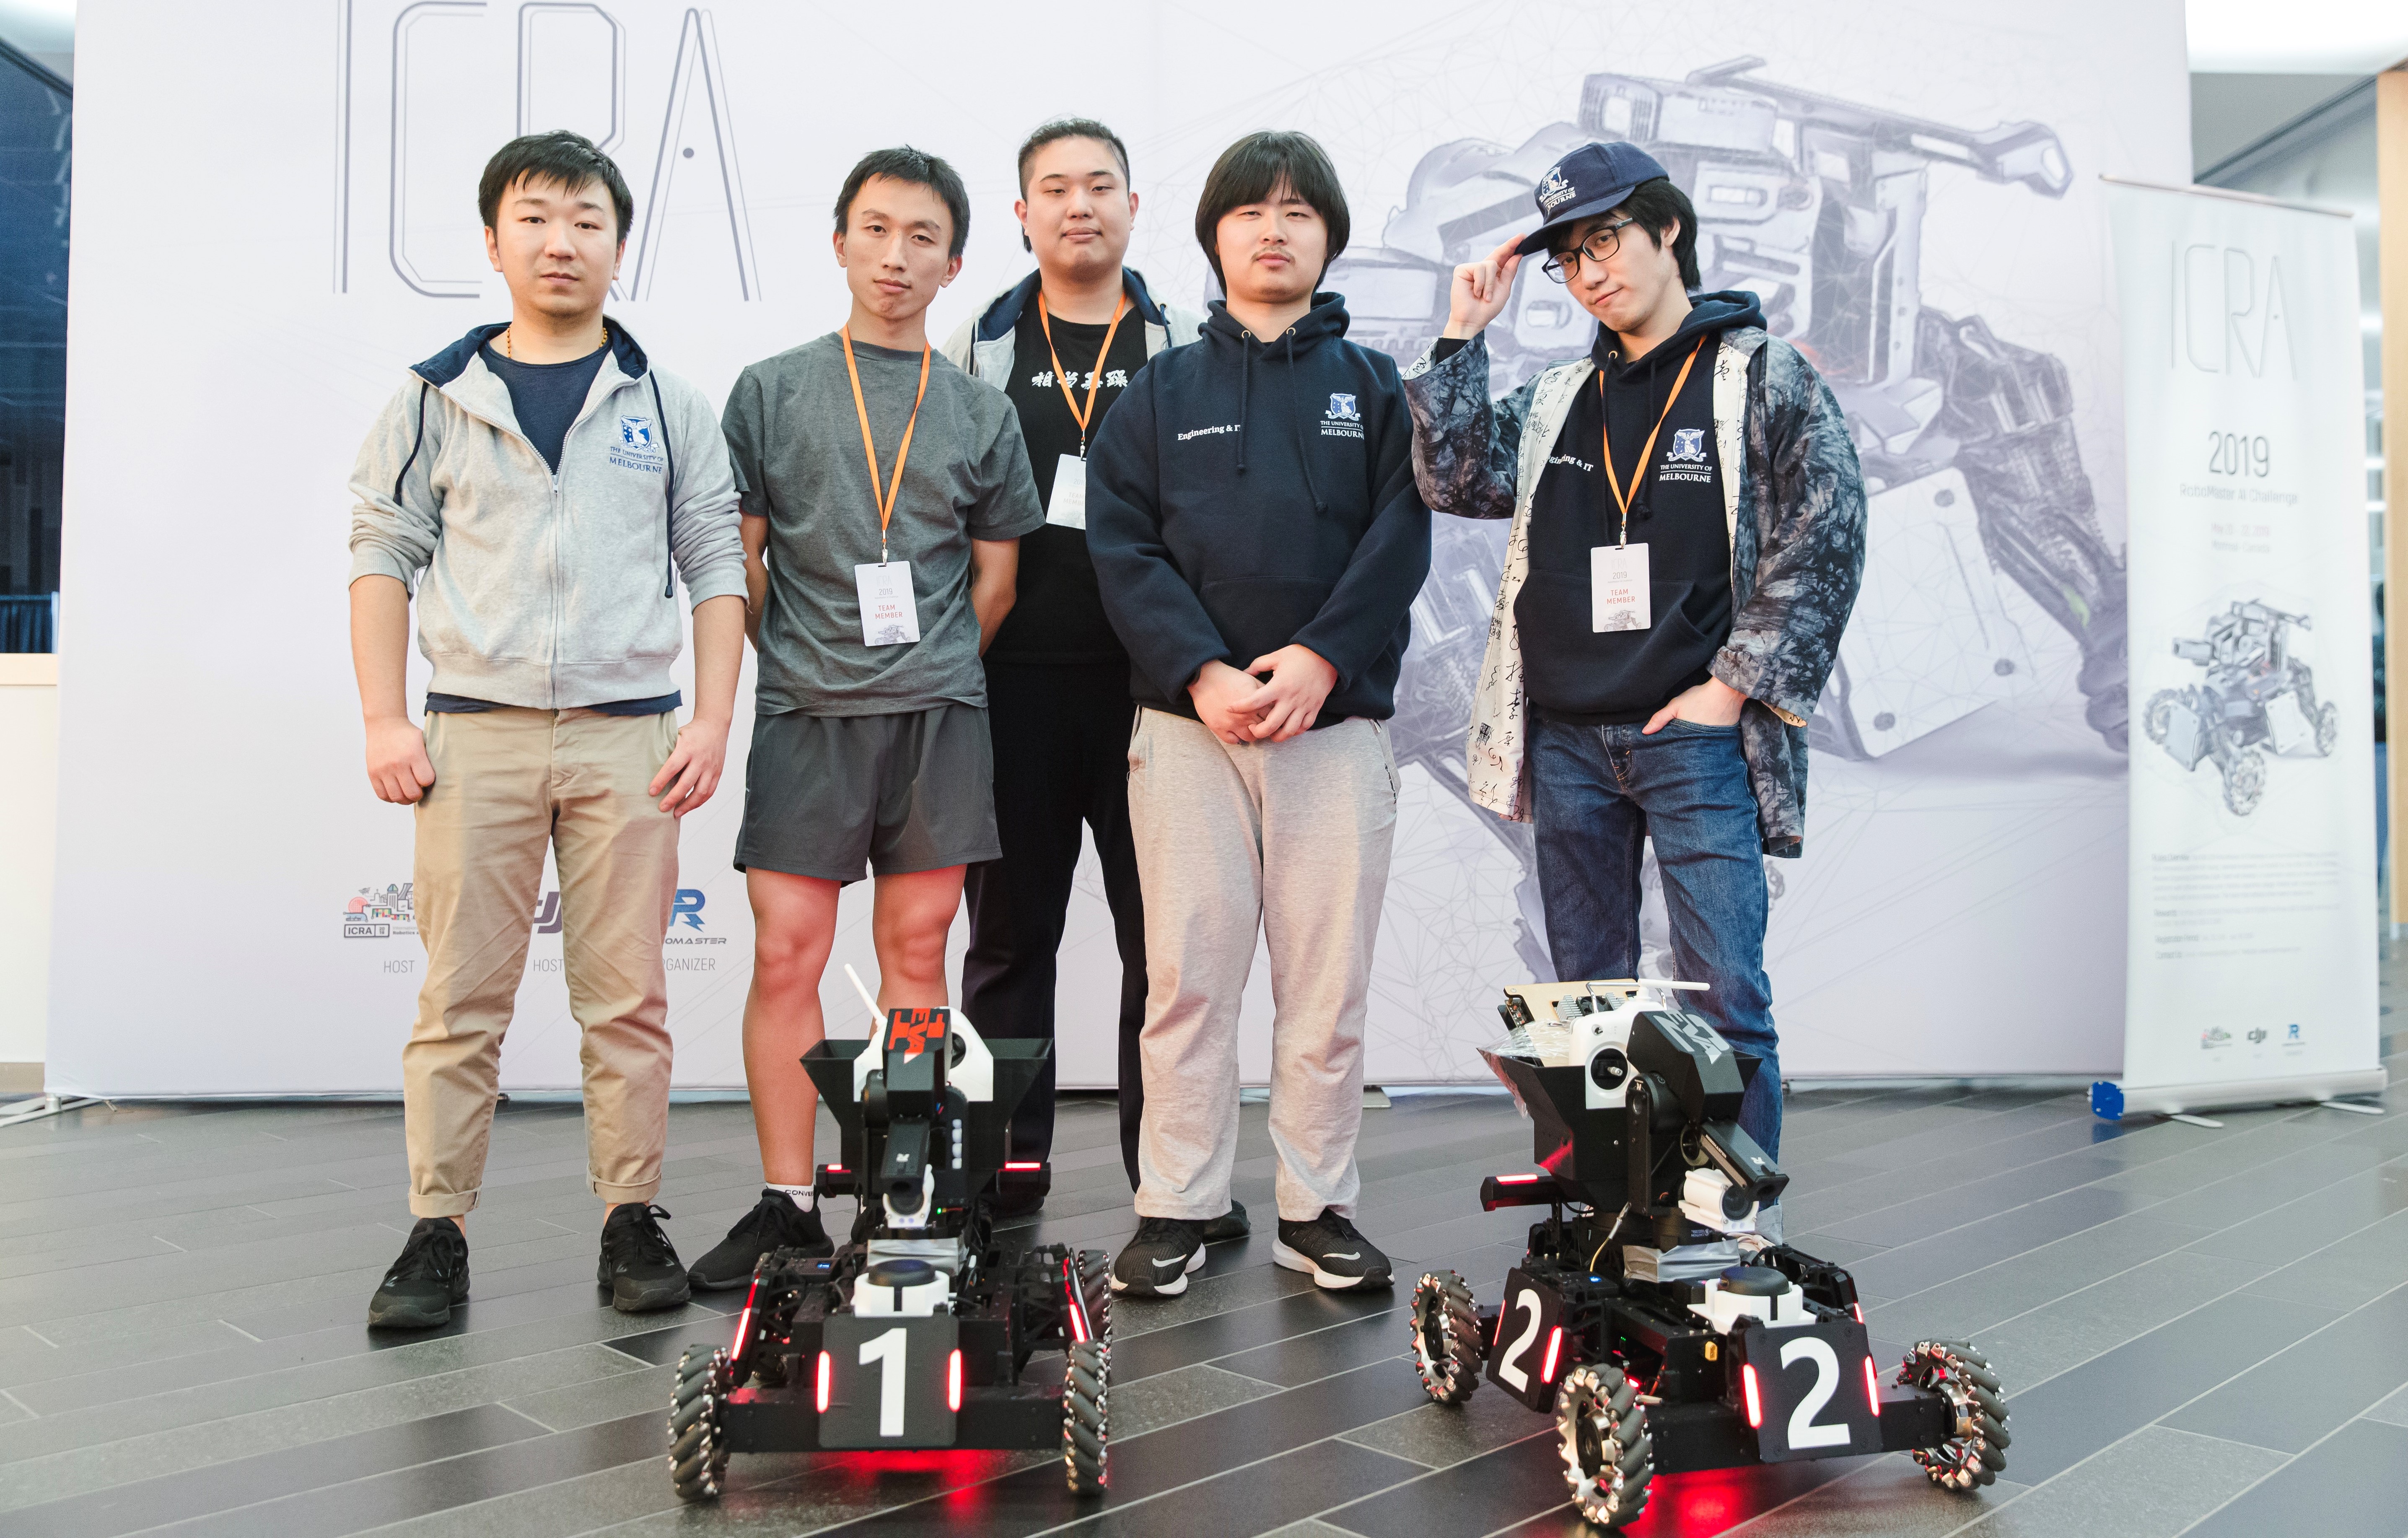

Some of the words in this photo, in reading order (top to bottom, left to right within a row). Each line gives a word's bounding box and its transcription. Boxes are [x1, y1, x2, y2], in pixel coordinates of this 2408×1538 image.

[2171, 241, 2297, 381] ICRA
[1178, 426, 1225, 440] Engineering
[1321, 429, 1364, 440] MELBOURN
[622, 449, 656, 460] UNIVERSITY
[2208, 431, 2270, 477] 2019
[609, 456, 662, 474] MELBOURNE
[1583, 463, 1594, 471] IT
[1659, 473, 1711, 482] MELBOURNE
[2180, 483, 2235, 501] RoboMaster
[2249, 488, 2298, 506] Challenge
[1063, 498, 1084, 506] MEMBE
[1607, 596, 1636, 604] MEMBER
[384, 960, 415, 973] HOST
[533, 959, 563, 972] HOST
[662, 958, 715, 970] GANIZER
[1498, 1289, 1542, 1393] 2
[858, 1327, 907, 1437] 1
[1780, 1336, 1851, 1450] 2
